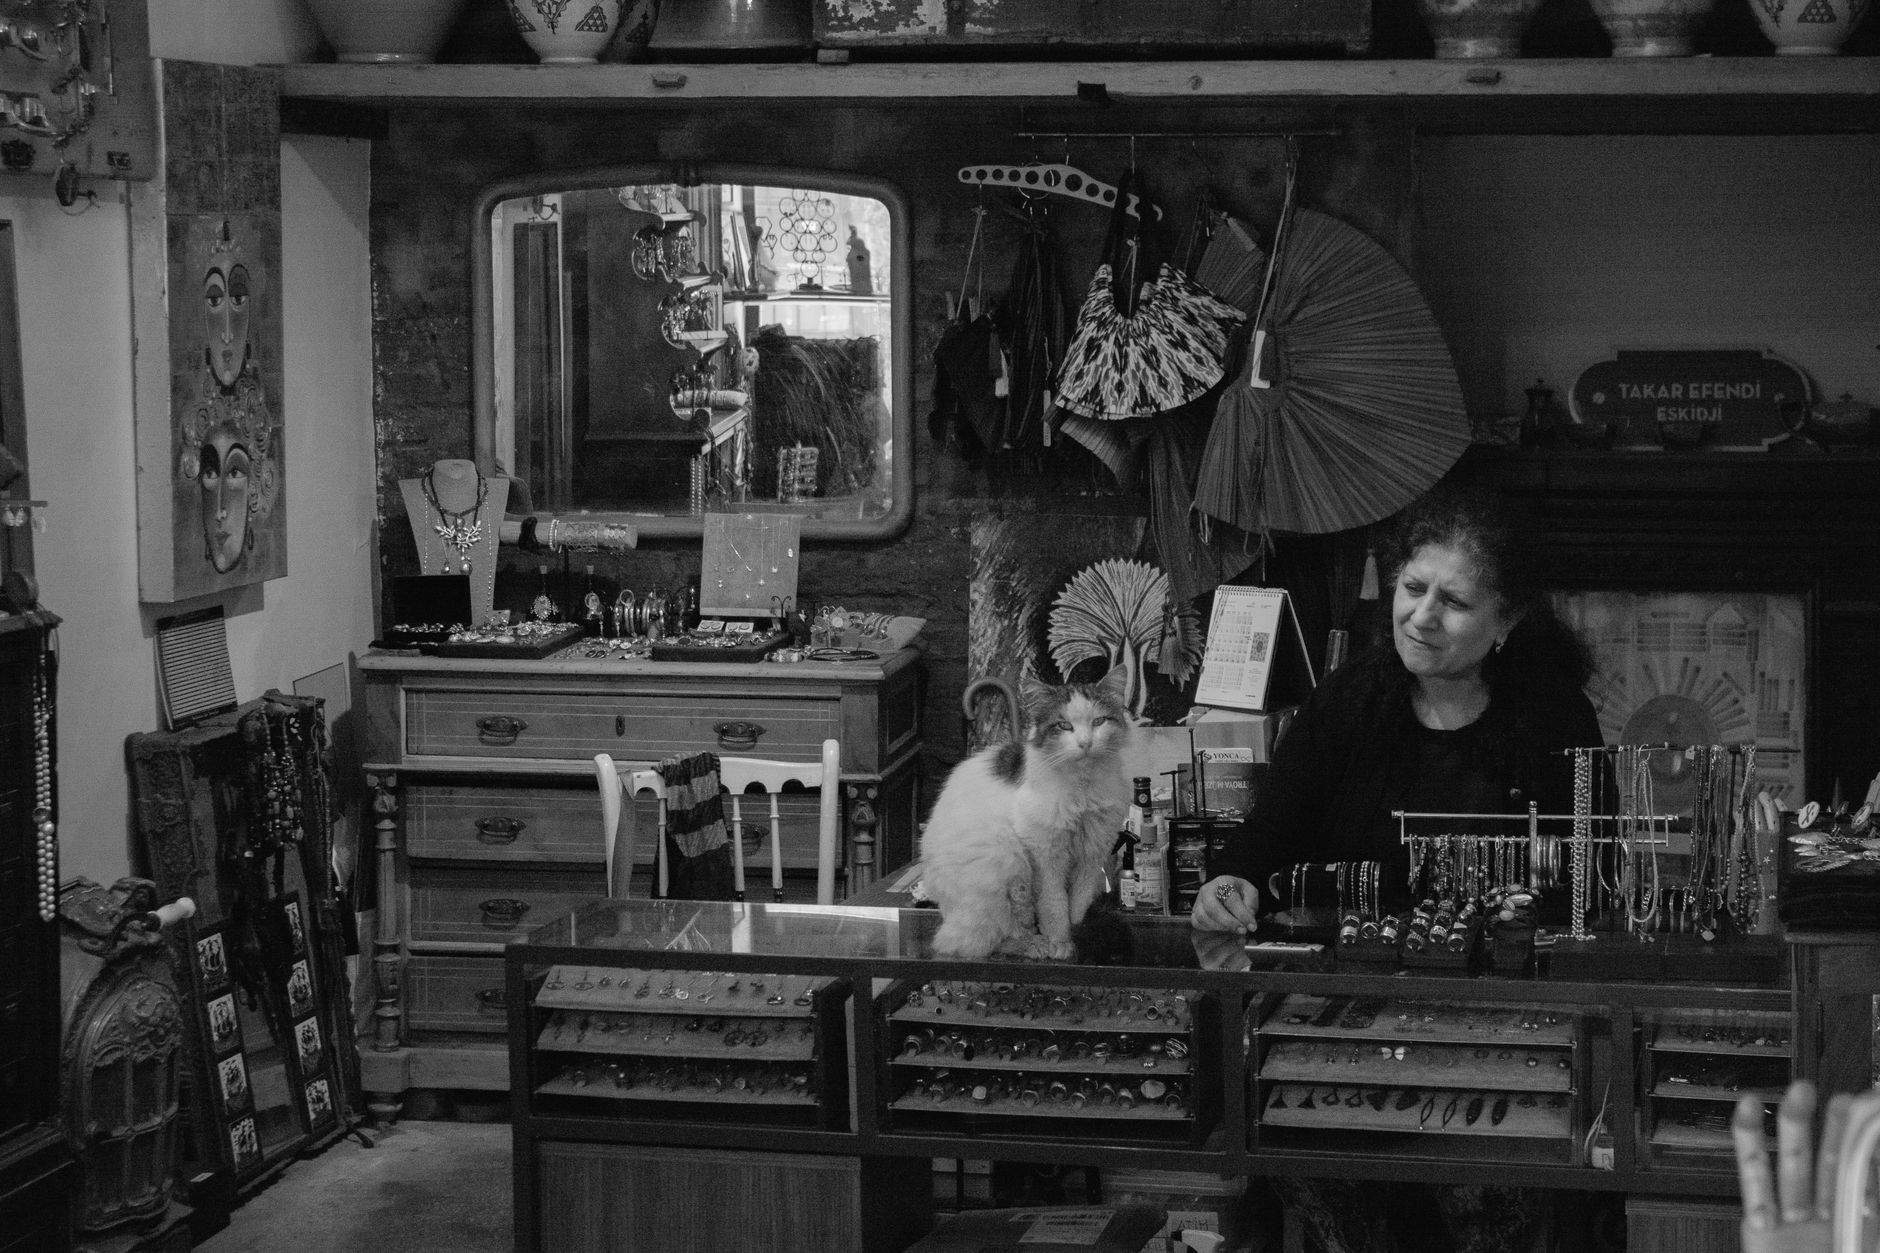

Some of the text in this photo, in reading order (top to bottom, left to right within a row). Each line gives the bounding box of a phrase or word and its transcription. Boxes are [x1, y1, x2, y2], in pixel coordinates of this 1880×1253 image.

[1618, 380, 1761, 400] TAKAR EFENDİ
[1657, 403, 1723, 422] ESKİDJİ
[1213, 752, 1239, 760] YONCA
[1224, 780, 1248, 789] TROYA
